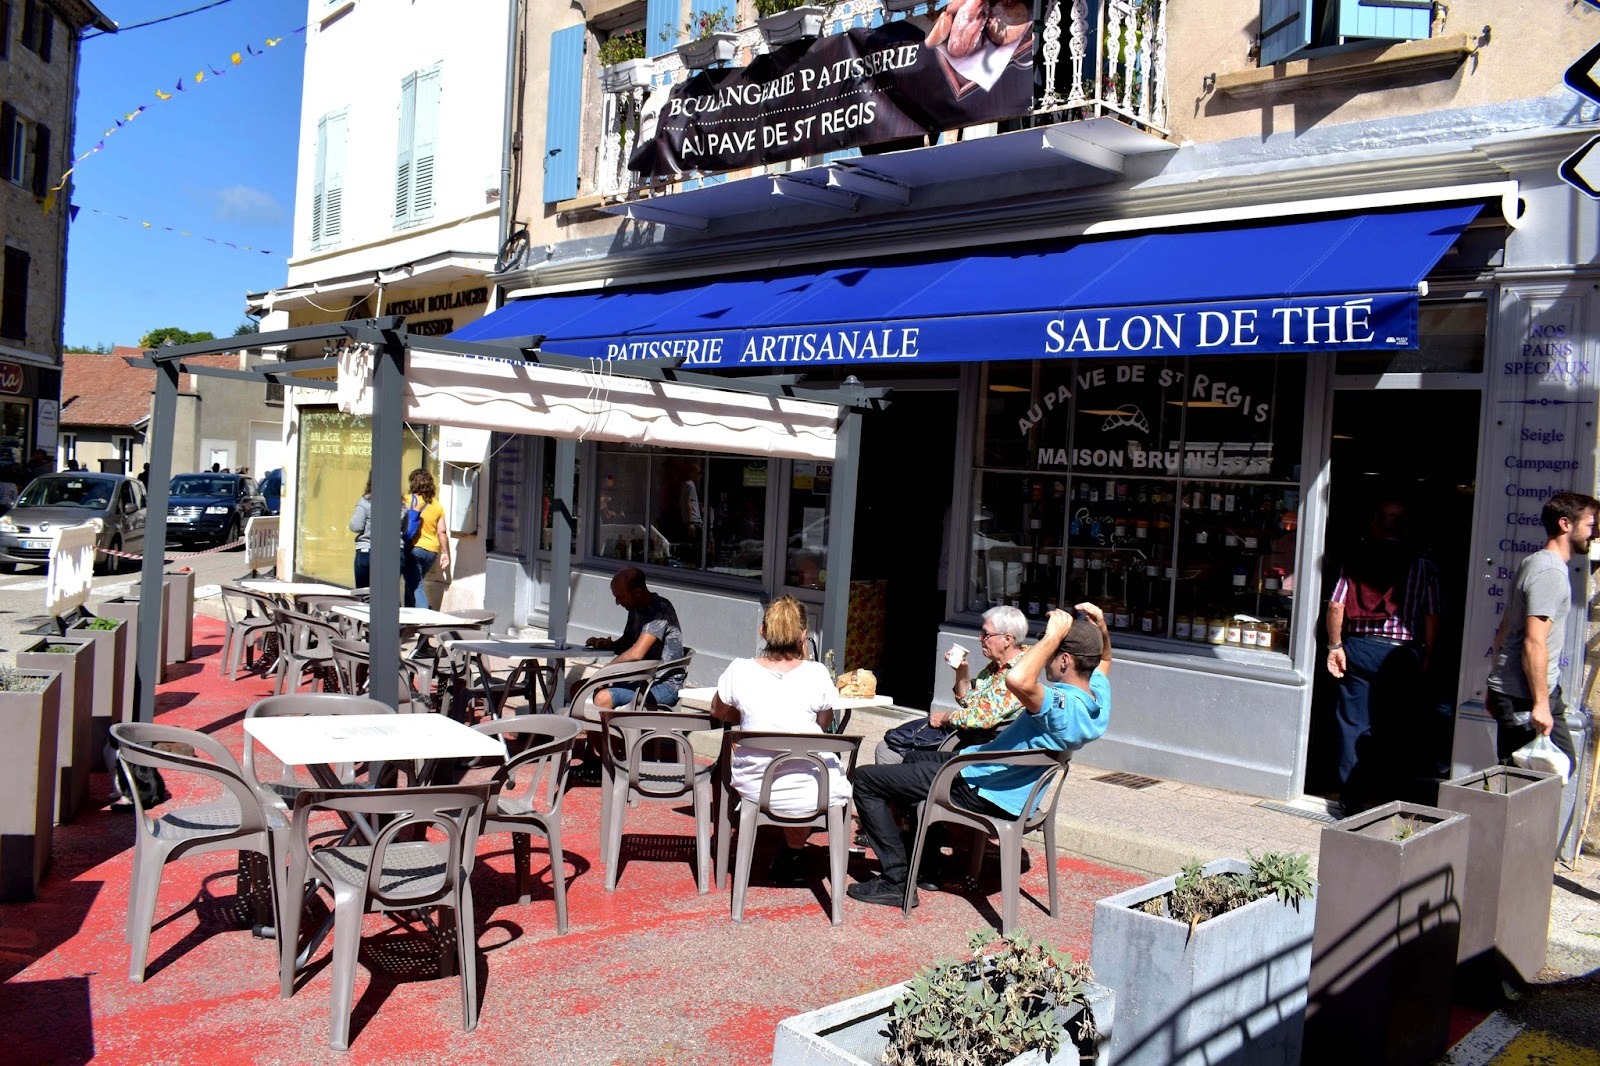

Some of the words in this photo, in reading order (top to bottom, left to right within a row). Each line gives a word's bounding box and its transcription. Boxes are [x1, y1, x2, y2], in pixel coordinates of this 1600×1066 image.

[668, 72, 796, 117] BOULANGERIE
[800, 44, 920, 91] PATISSERIE
[681, 136, 705, 160] AU
[707, 129, 757, 155] PAVE
[763, 124, 788, 148] DE
[793, 115, 816, 142] ST
[821, 101, 876, 136] REGIS
[385, 297, 426, 316] ARTISAN
[428, 287, 488, 312] BOULANGER
[1045, 313, 1185, 353] SALON
[1196, 309, 1259, 348] DE
[1272, 298, 1375, 346] THÉ
[1531, 325, 1566, 338] NOS
[740, 328, 920, 363] ARTISANALE
[1522, 343, 1573, 356] PAINS
[1504, 361, 1590, 375] SPECIAUX
[1017, 403, 1043, 436] AU
[1116, 365, 1145, 383] DE
[1192, 373, 1269, 423] REGIS
[1520, 428, 1564, 445] Seigle
[1037, 447, 1124, 468] MAISON
[1504, 456, 1579, 473] Campagne
[1505, 484, 1572, 501] Complet
[1488, 585, 1504, 597] de
